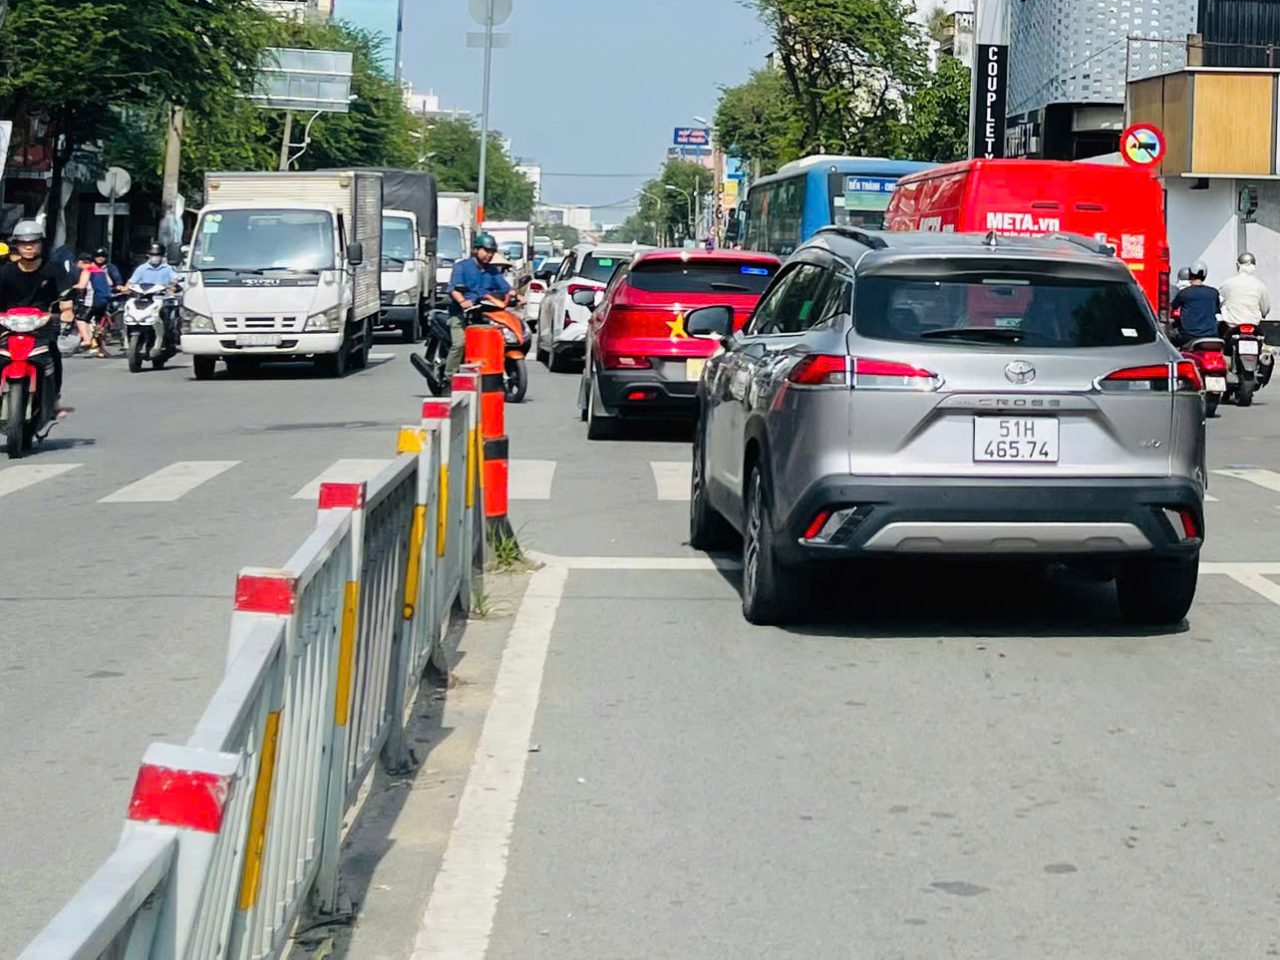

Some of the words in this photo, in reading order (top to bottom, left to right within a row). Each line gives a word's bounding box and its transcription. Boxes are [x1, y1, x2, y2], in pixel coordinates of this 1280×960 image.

[987, 212, 1060, 231] META.vn
[978, 399, 1061, 407] CROSS
[999, 420, 1035, 437] 51H
[984, 441, 1049, 458] 465.74
